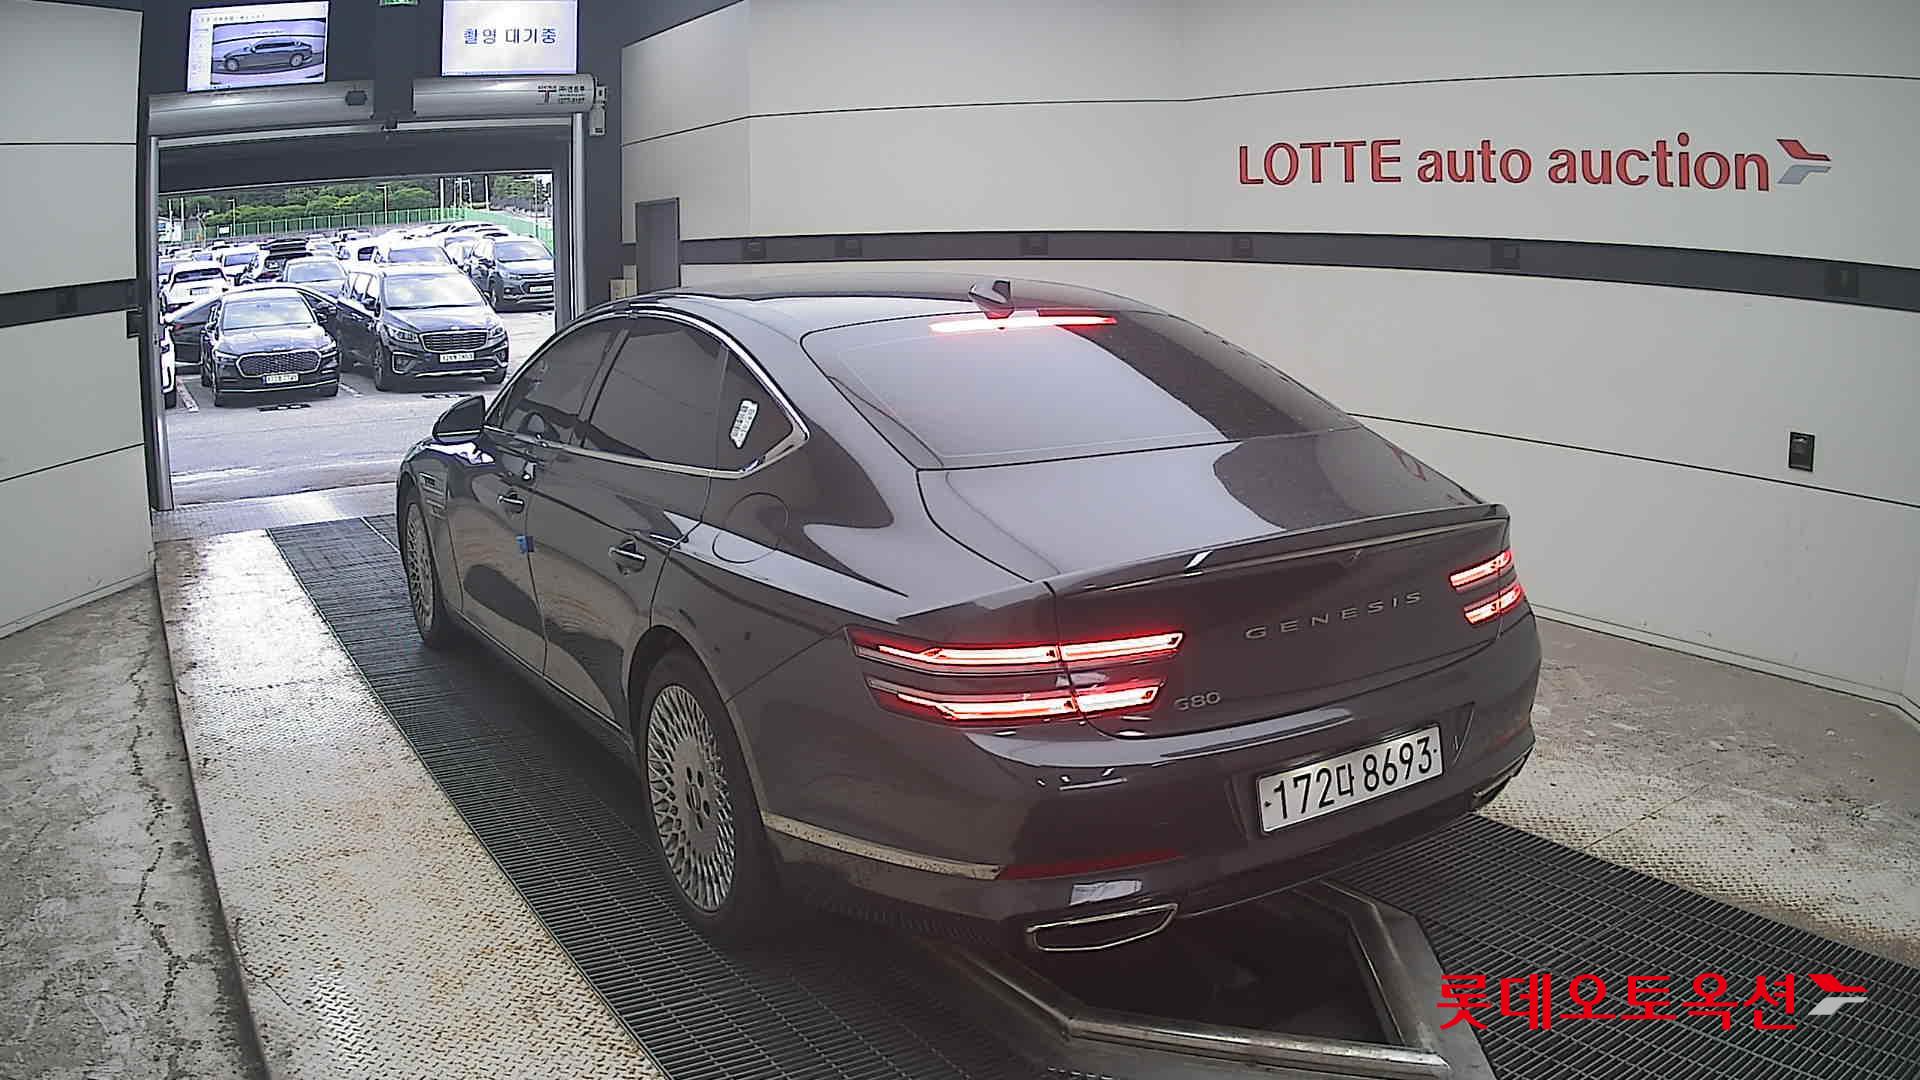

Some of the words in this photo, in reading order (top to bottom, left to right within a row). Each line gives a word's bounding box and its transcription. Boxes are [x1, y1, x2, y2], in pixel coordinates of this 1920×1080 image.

[505, 28, 557, 45] 대기중
[1239, 139, 1401, 186] LOTTE
[1417, 139, 1532, 184] auto
[1548, 132, 1769, 191] auction
[1245, 591, 1422, 639] GENESIS
[1174, 691, 1221, 711] G80
[1273, 762, 1355, 820] 172다
[1362, 735, 1433, 792] 8693
